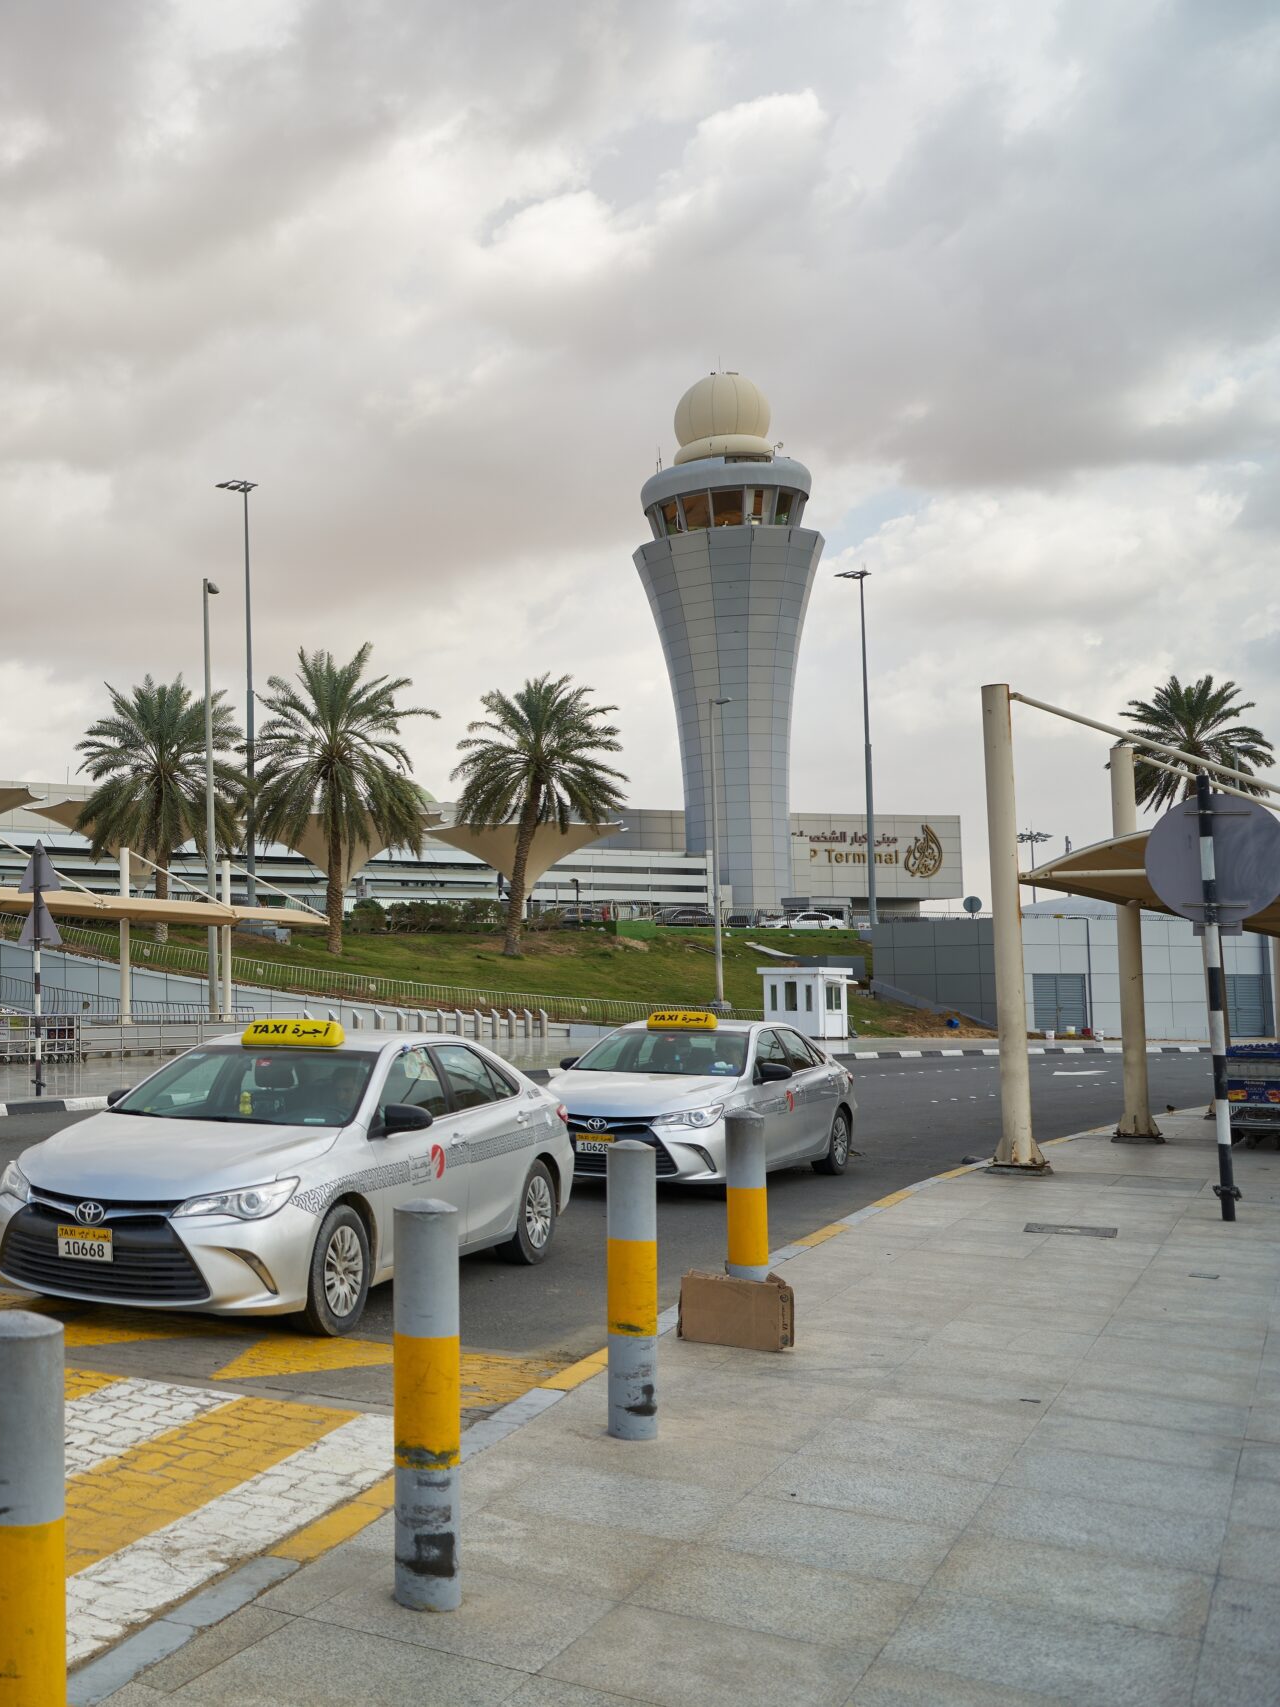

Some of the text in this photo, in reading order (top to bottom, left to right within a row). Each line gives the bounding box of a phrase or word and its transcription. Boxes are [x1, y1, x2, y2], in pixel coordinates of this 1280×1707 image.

[824, 848, 899, 864] Termnal
[682, 1014, 708, 1023] أجرة
[253, 1024, 288, 1034] TAXI
[292, 1023, 332, 1037] أجرة
[60, 1228, 76, 1237] TAXI
[65, 1241, 104, 1258] 10668
